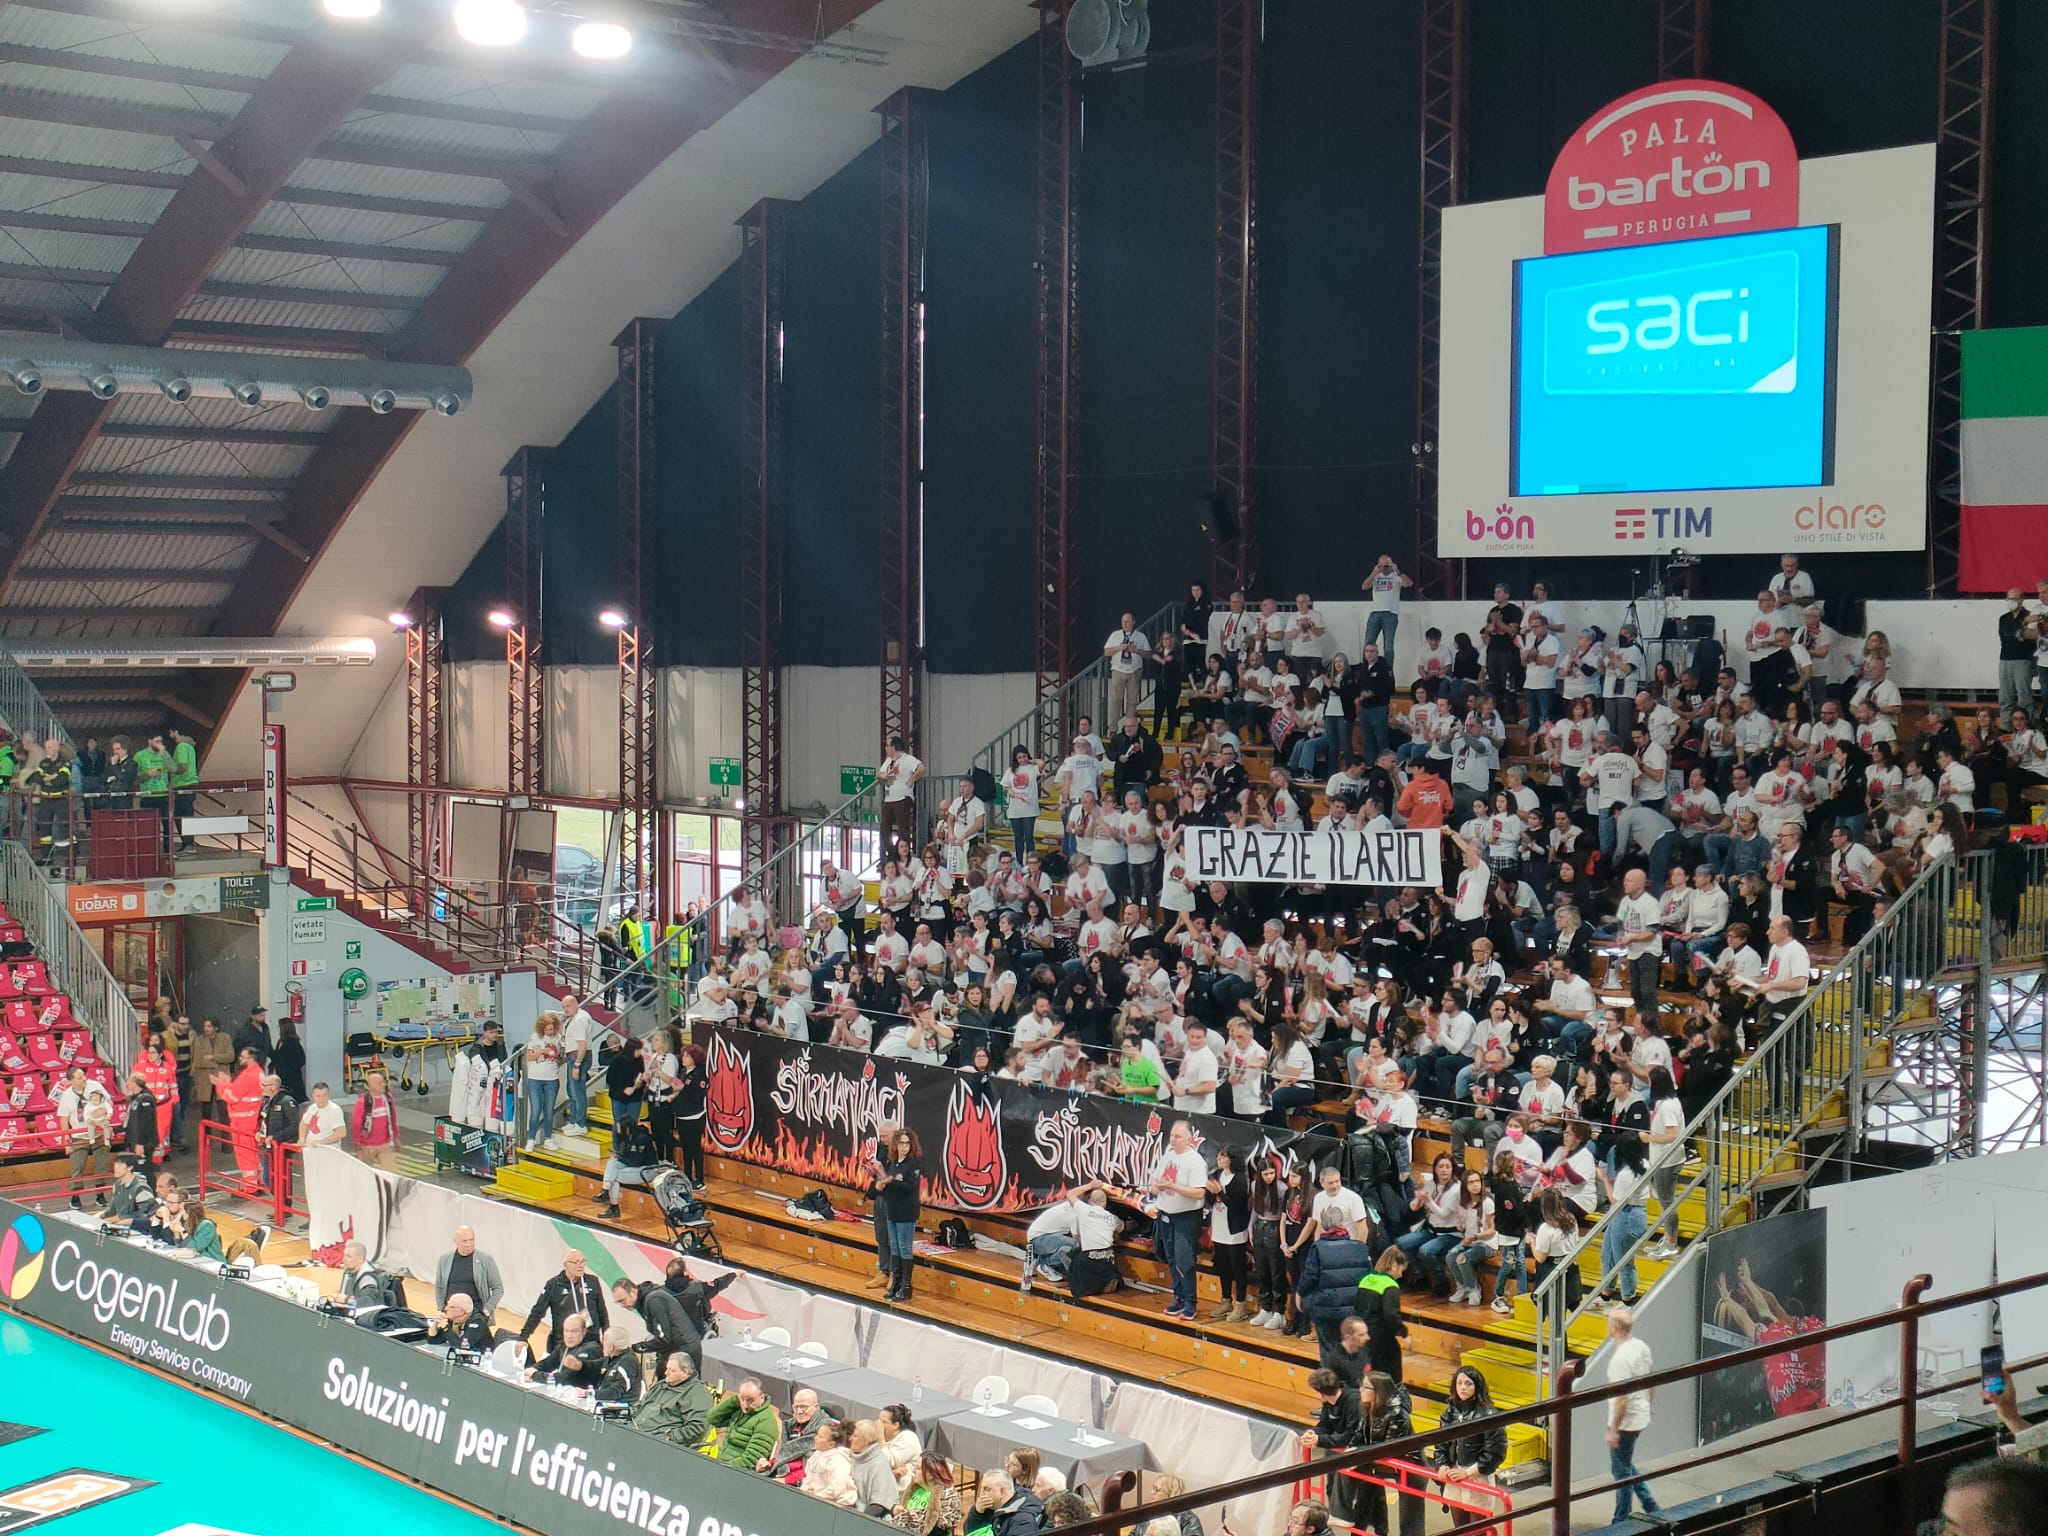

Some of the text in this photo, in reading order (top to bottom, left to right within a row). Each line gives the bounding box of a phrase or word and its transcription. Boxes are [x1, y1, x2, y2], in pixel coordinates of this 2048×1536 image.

[1620, 118, 1717, 156] PALA
[1623, 214, 1709, 236] PERUGIA
[1586, 287, 1749, 355] saci
[1652, 507, 1713, 538] TIM
[1795, 496, 1887, 530] claro
[1794, 532, 1886, 543] UNO STILE DI VISTA
[841, 766, 876, 776] USCITA EXIT
[266, 770, 275, 843] BAR
[1198, 830, 1426, 883] GRAZIE ILARIO
[225, 877, 255, 888] TOILET
[75, 899, 118, 911] LIOBAR
[294, 920, 324, 929] vietato
[294, 931, 323, 939] fumare
[51, 1240, 230, 1351] CogenLab
[111, 1324, 253, 1399] Energy Service Company
[323, 1357, 450, 1445] Soluzioni
[455, 1418, 508, 1465] per
[511, 1428, 690, 1536] l'efficienza
